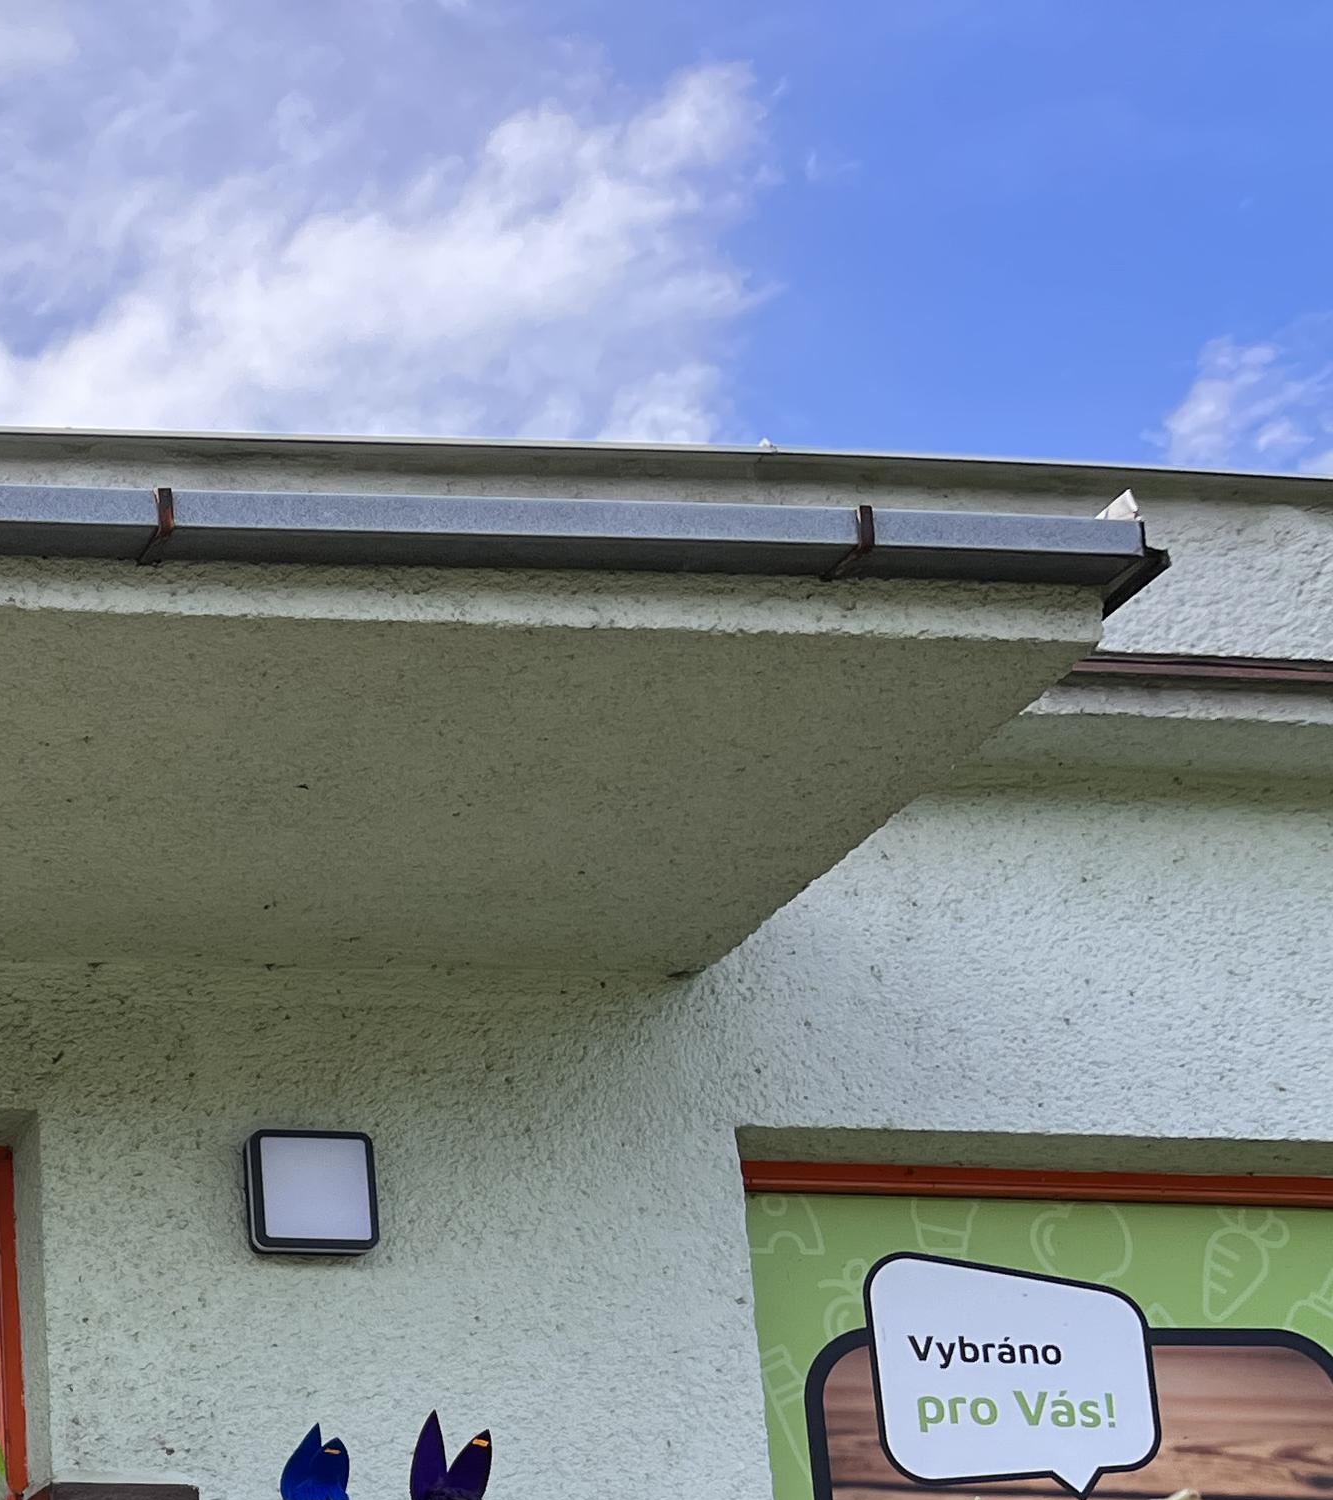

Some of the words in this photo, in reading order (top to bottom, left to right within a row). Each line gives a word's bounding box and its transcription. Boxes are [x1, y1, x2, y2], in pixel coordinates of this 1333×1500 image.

[907, 1335, 1062, 1369] Vybráno
[917, 1394, 999, 1433] pro
[1013, 1390, 1118, 1430] Vás!
